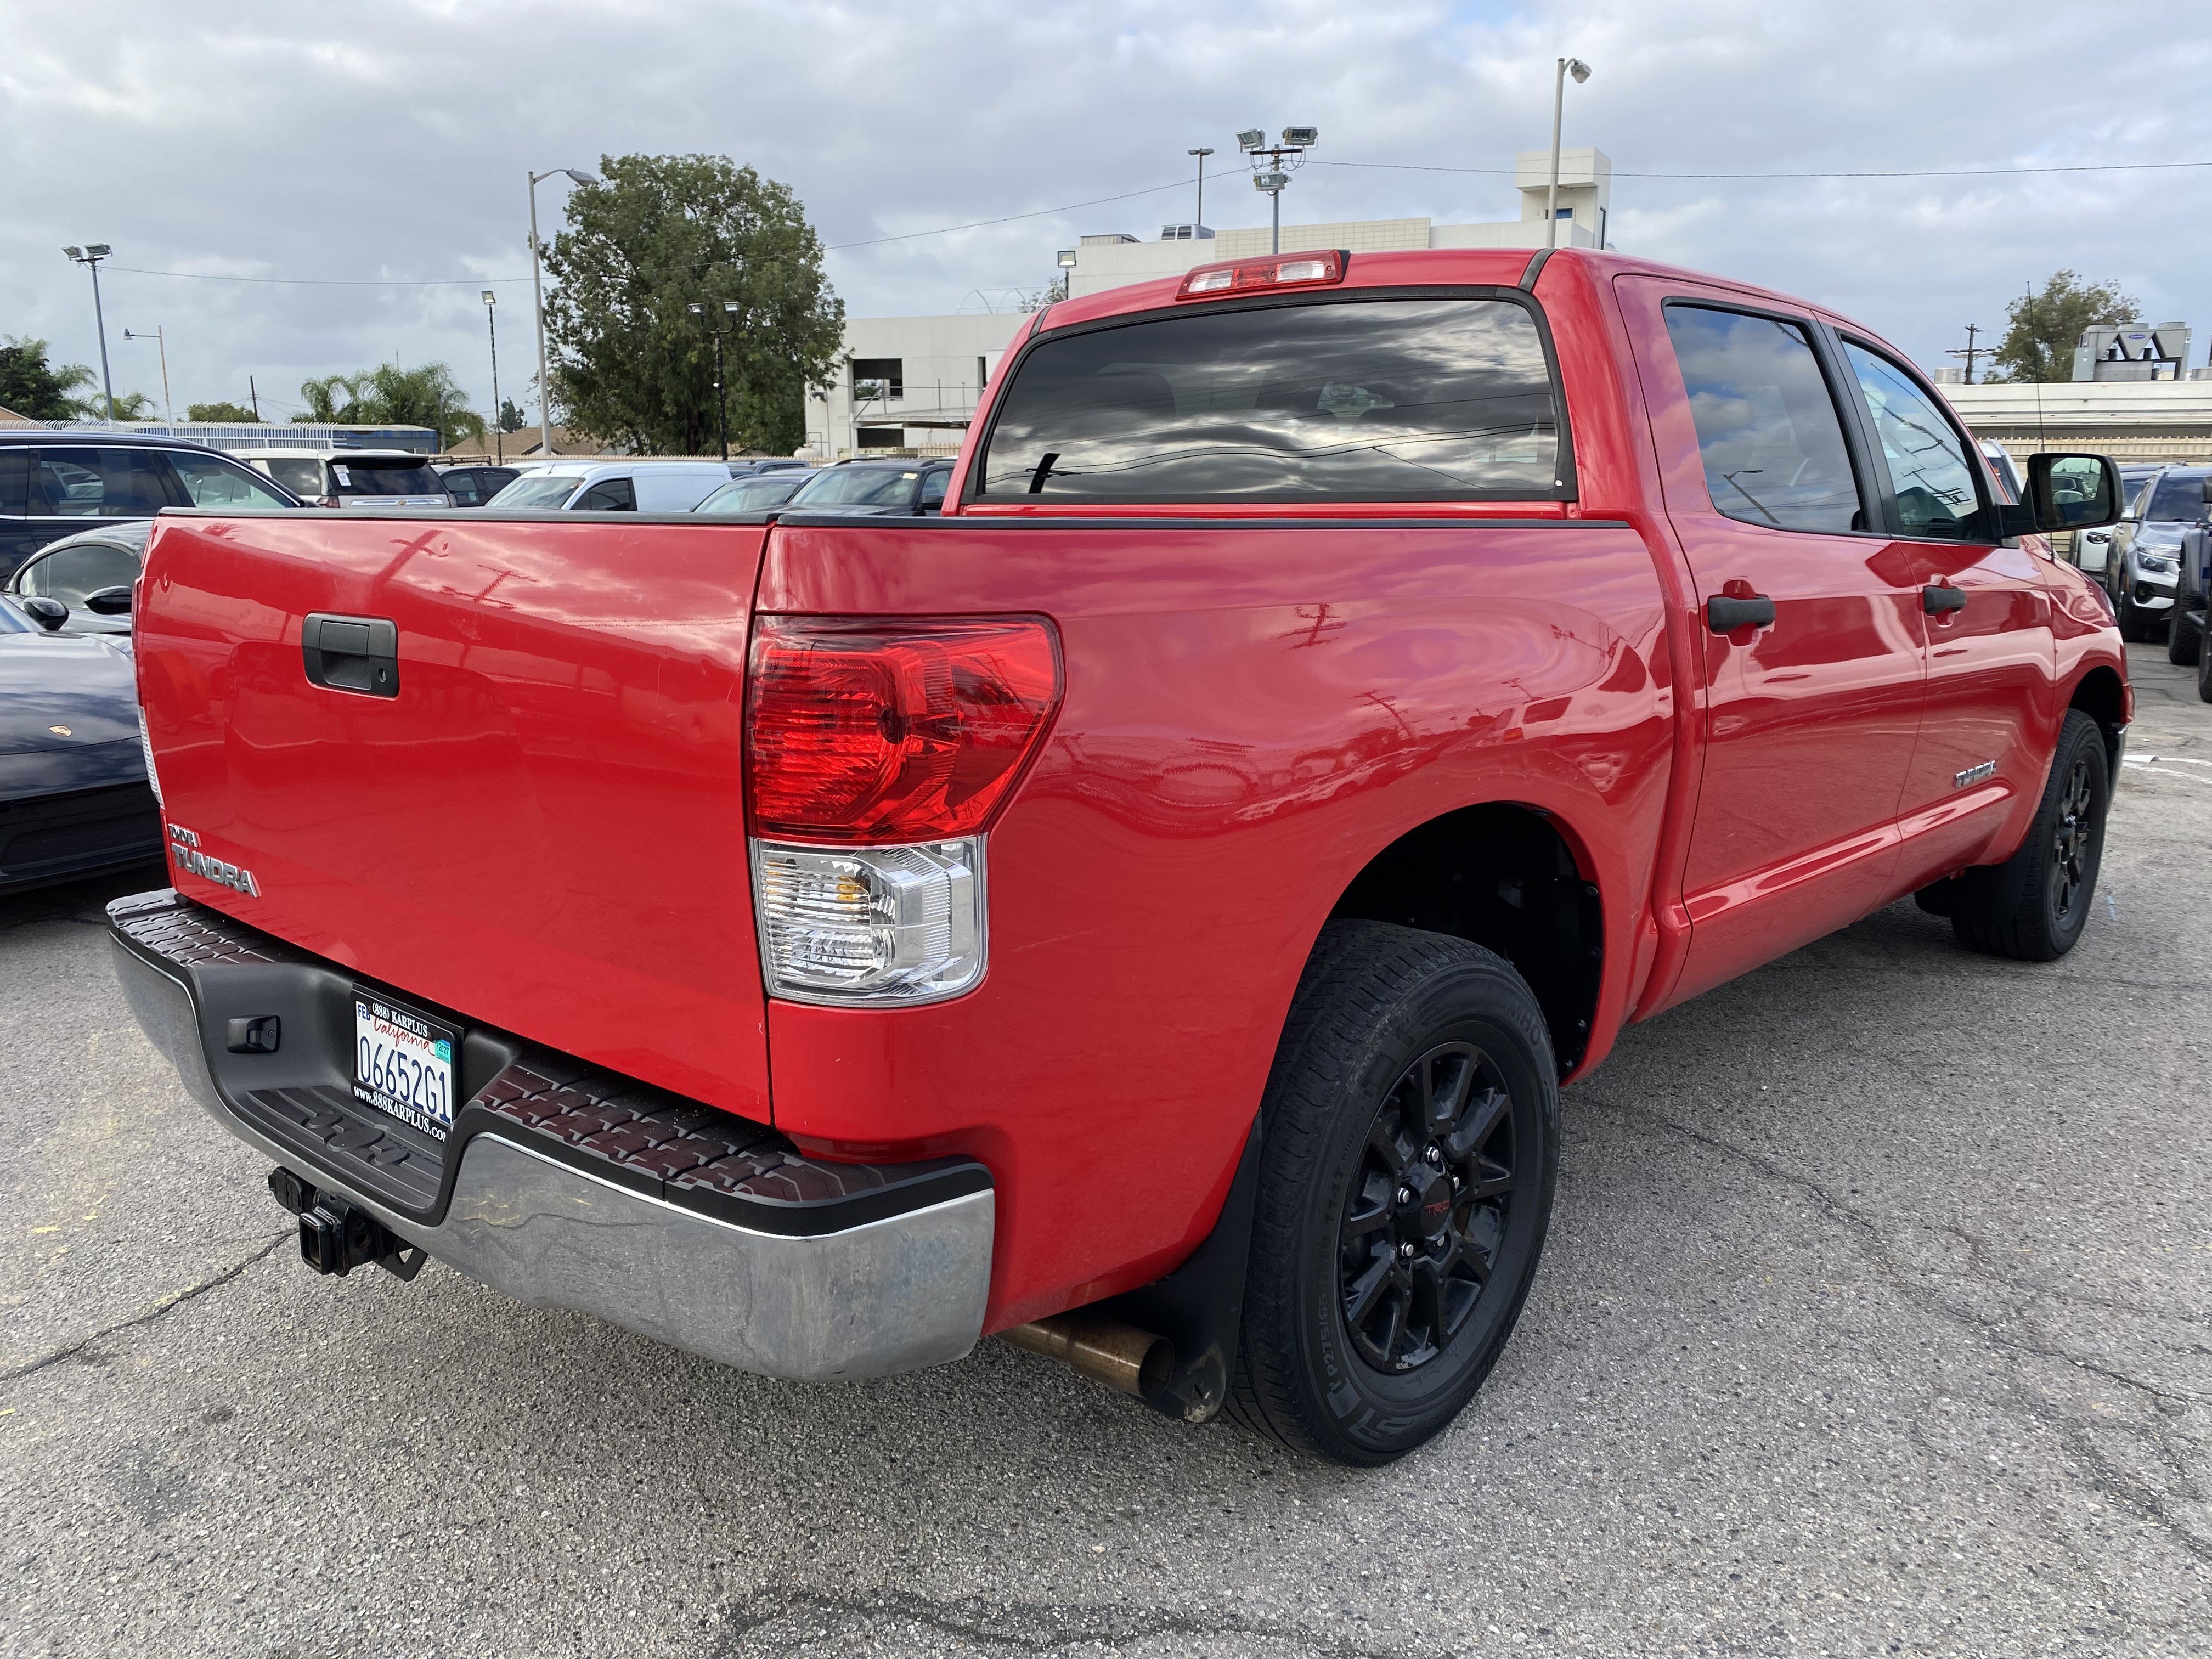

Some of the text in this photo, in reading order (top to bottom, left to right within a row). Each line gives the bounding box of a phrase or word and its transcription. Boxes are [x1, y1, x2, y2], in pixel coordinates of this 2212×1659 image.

[171, 842, 258, 898] TUNDRA
[372, 1002, 427, 1037] (888) KARPLUS
[374, 1017, 435, 1056] California
[360, 1036, 451, 1124] 06652G1
[1424, 1200, 1451, 1217] TRD
